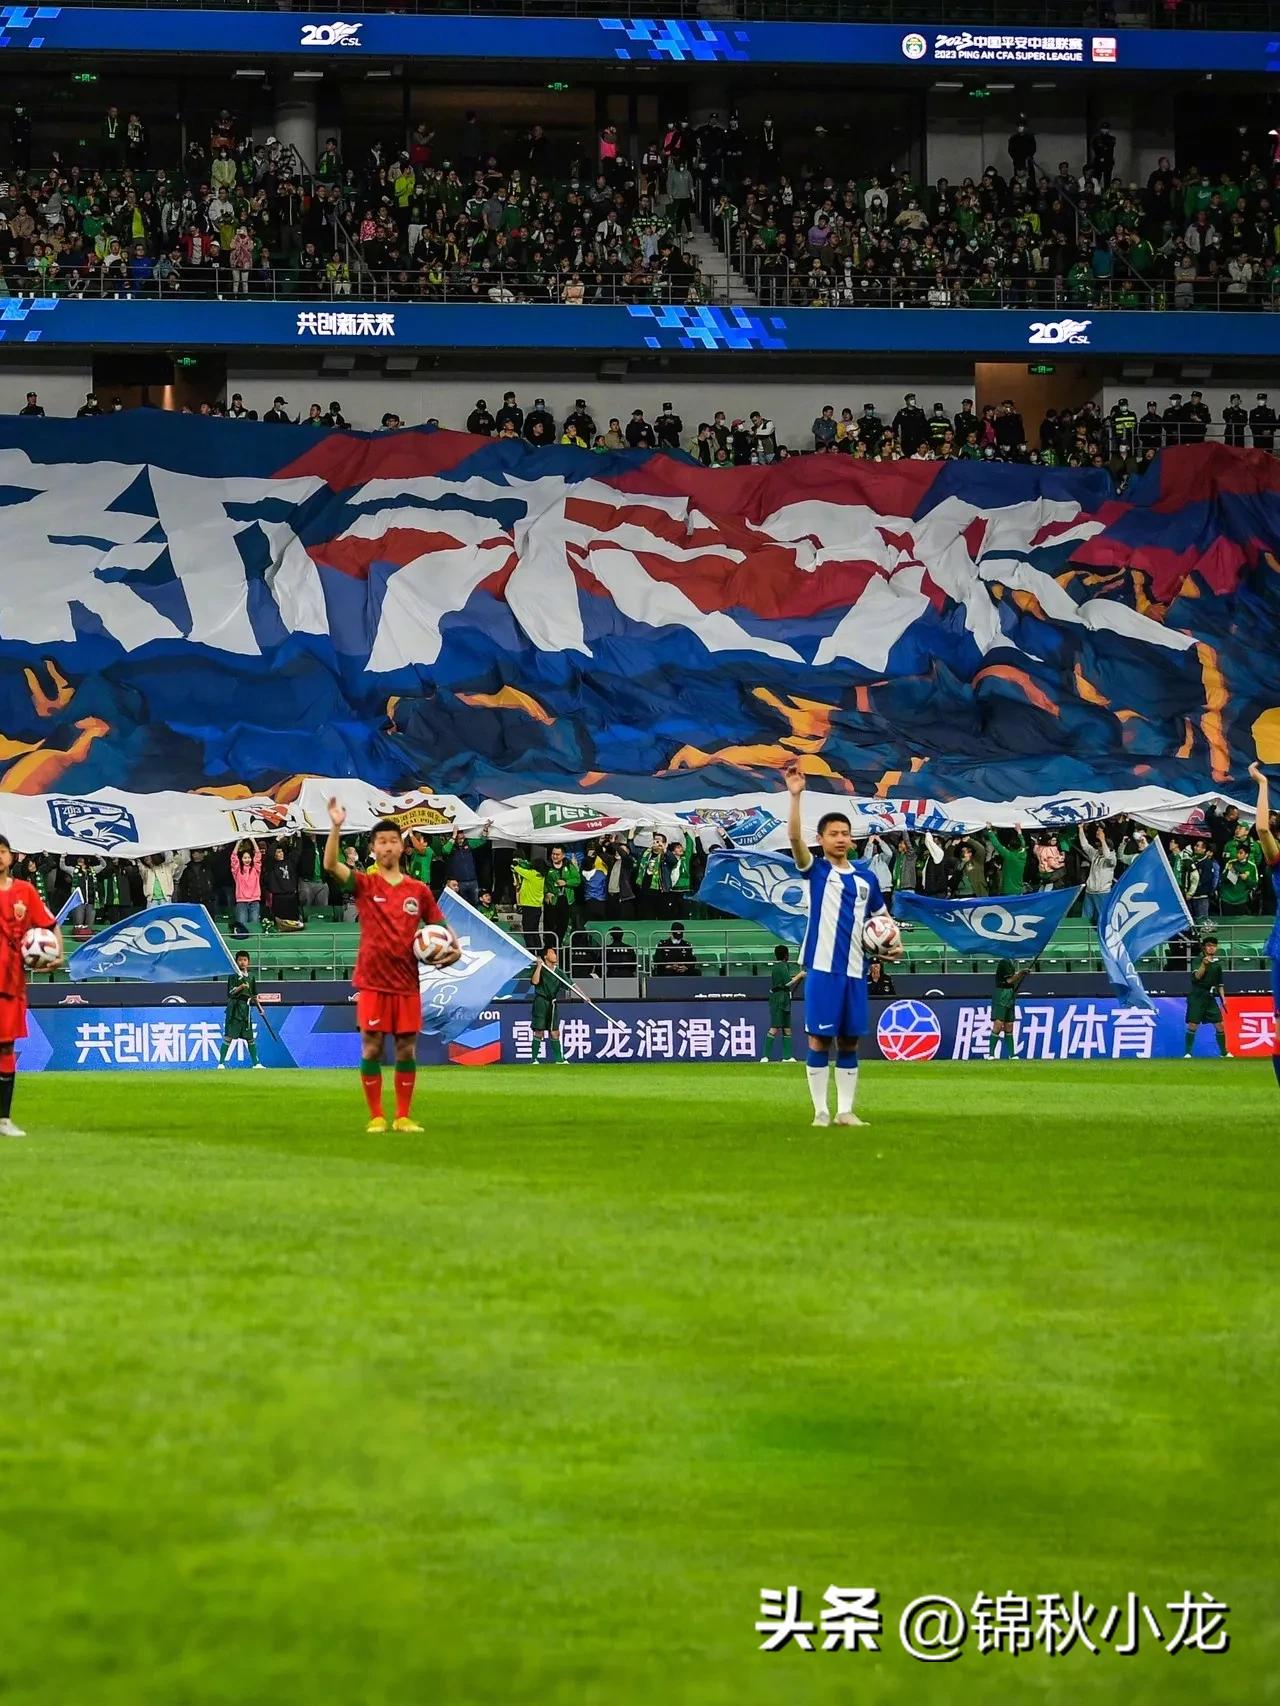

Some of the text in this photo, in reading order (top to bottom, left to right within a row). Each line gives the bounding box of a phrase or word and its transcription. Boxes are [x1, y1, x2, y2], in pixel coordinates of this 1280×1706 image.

[340, 37, 362, 46] CSL
[935, 50, 1083, 62] 2023 PING AN CFA SUPER LEAGUE
[297, 312, 395, 336] 共创新未来
[1069, 335, 1091, 344] CSL
[512, 1018, 756, 1060] 雪佛龙润滑油
[1238, 1011, 1277, 1050] 买
